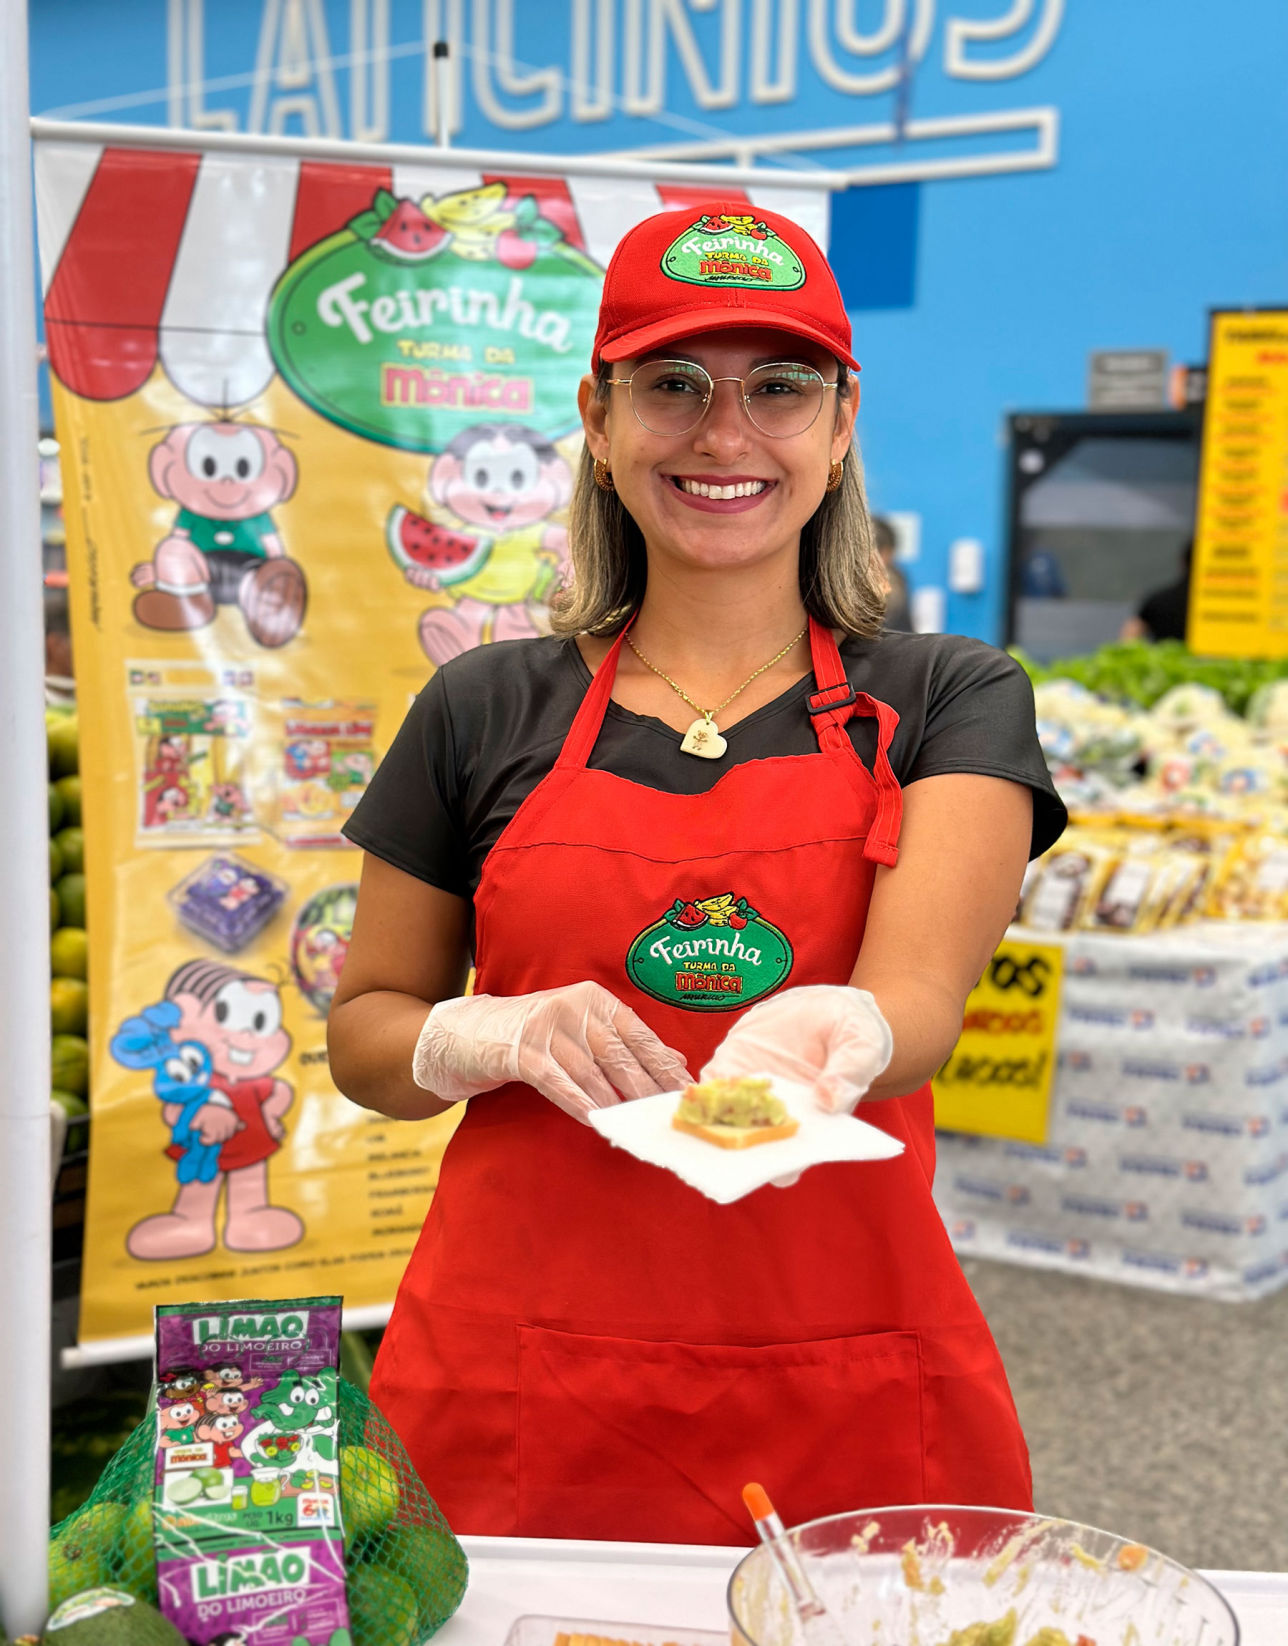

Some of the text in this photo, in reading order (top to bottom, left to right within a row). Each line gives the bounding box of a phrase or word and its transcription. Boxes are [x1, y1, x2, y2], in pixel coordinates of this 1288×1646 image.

[681, 236, 785, 266] Feirinha
[704, 251, 769, 267] TURMA DA
[316, 272, 573, 352] Feirinha
[397, 340, 515, 364] TURMA DA
[649, 932, 763, 966] Feirinha
[683, 961, 737, 972] TURMA DA
[976, 951, 1051, 998] OS
[202, 1340, 303, 1353] DO LIMOEIRO
[266, 1509, 294, 1527] 1kg
[197, 1589, 307, 1618] DO LIMOEIRO
